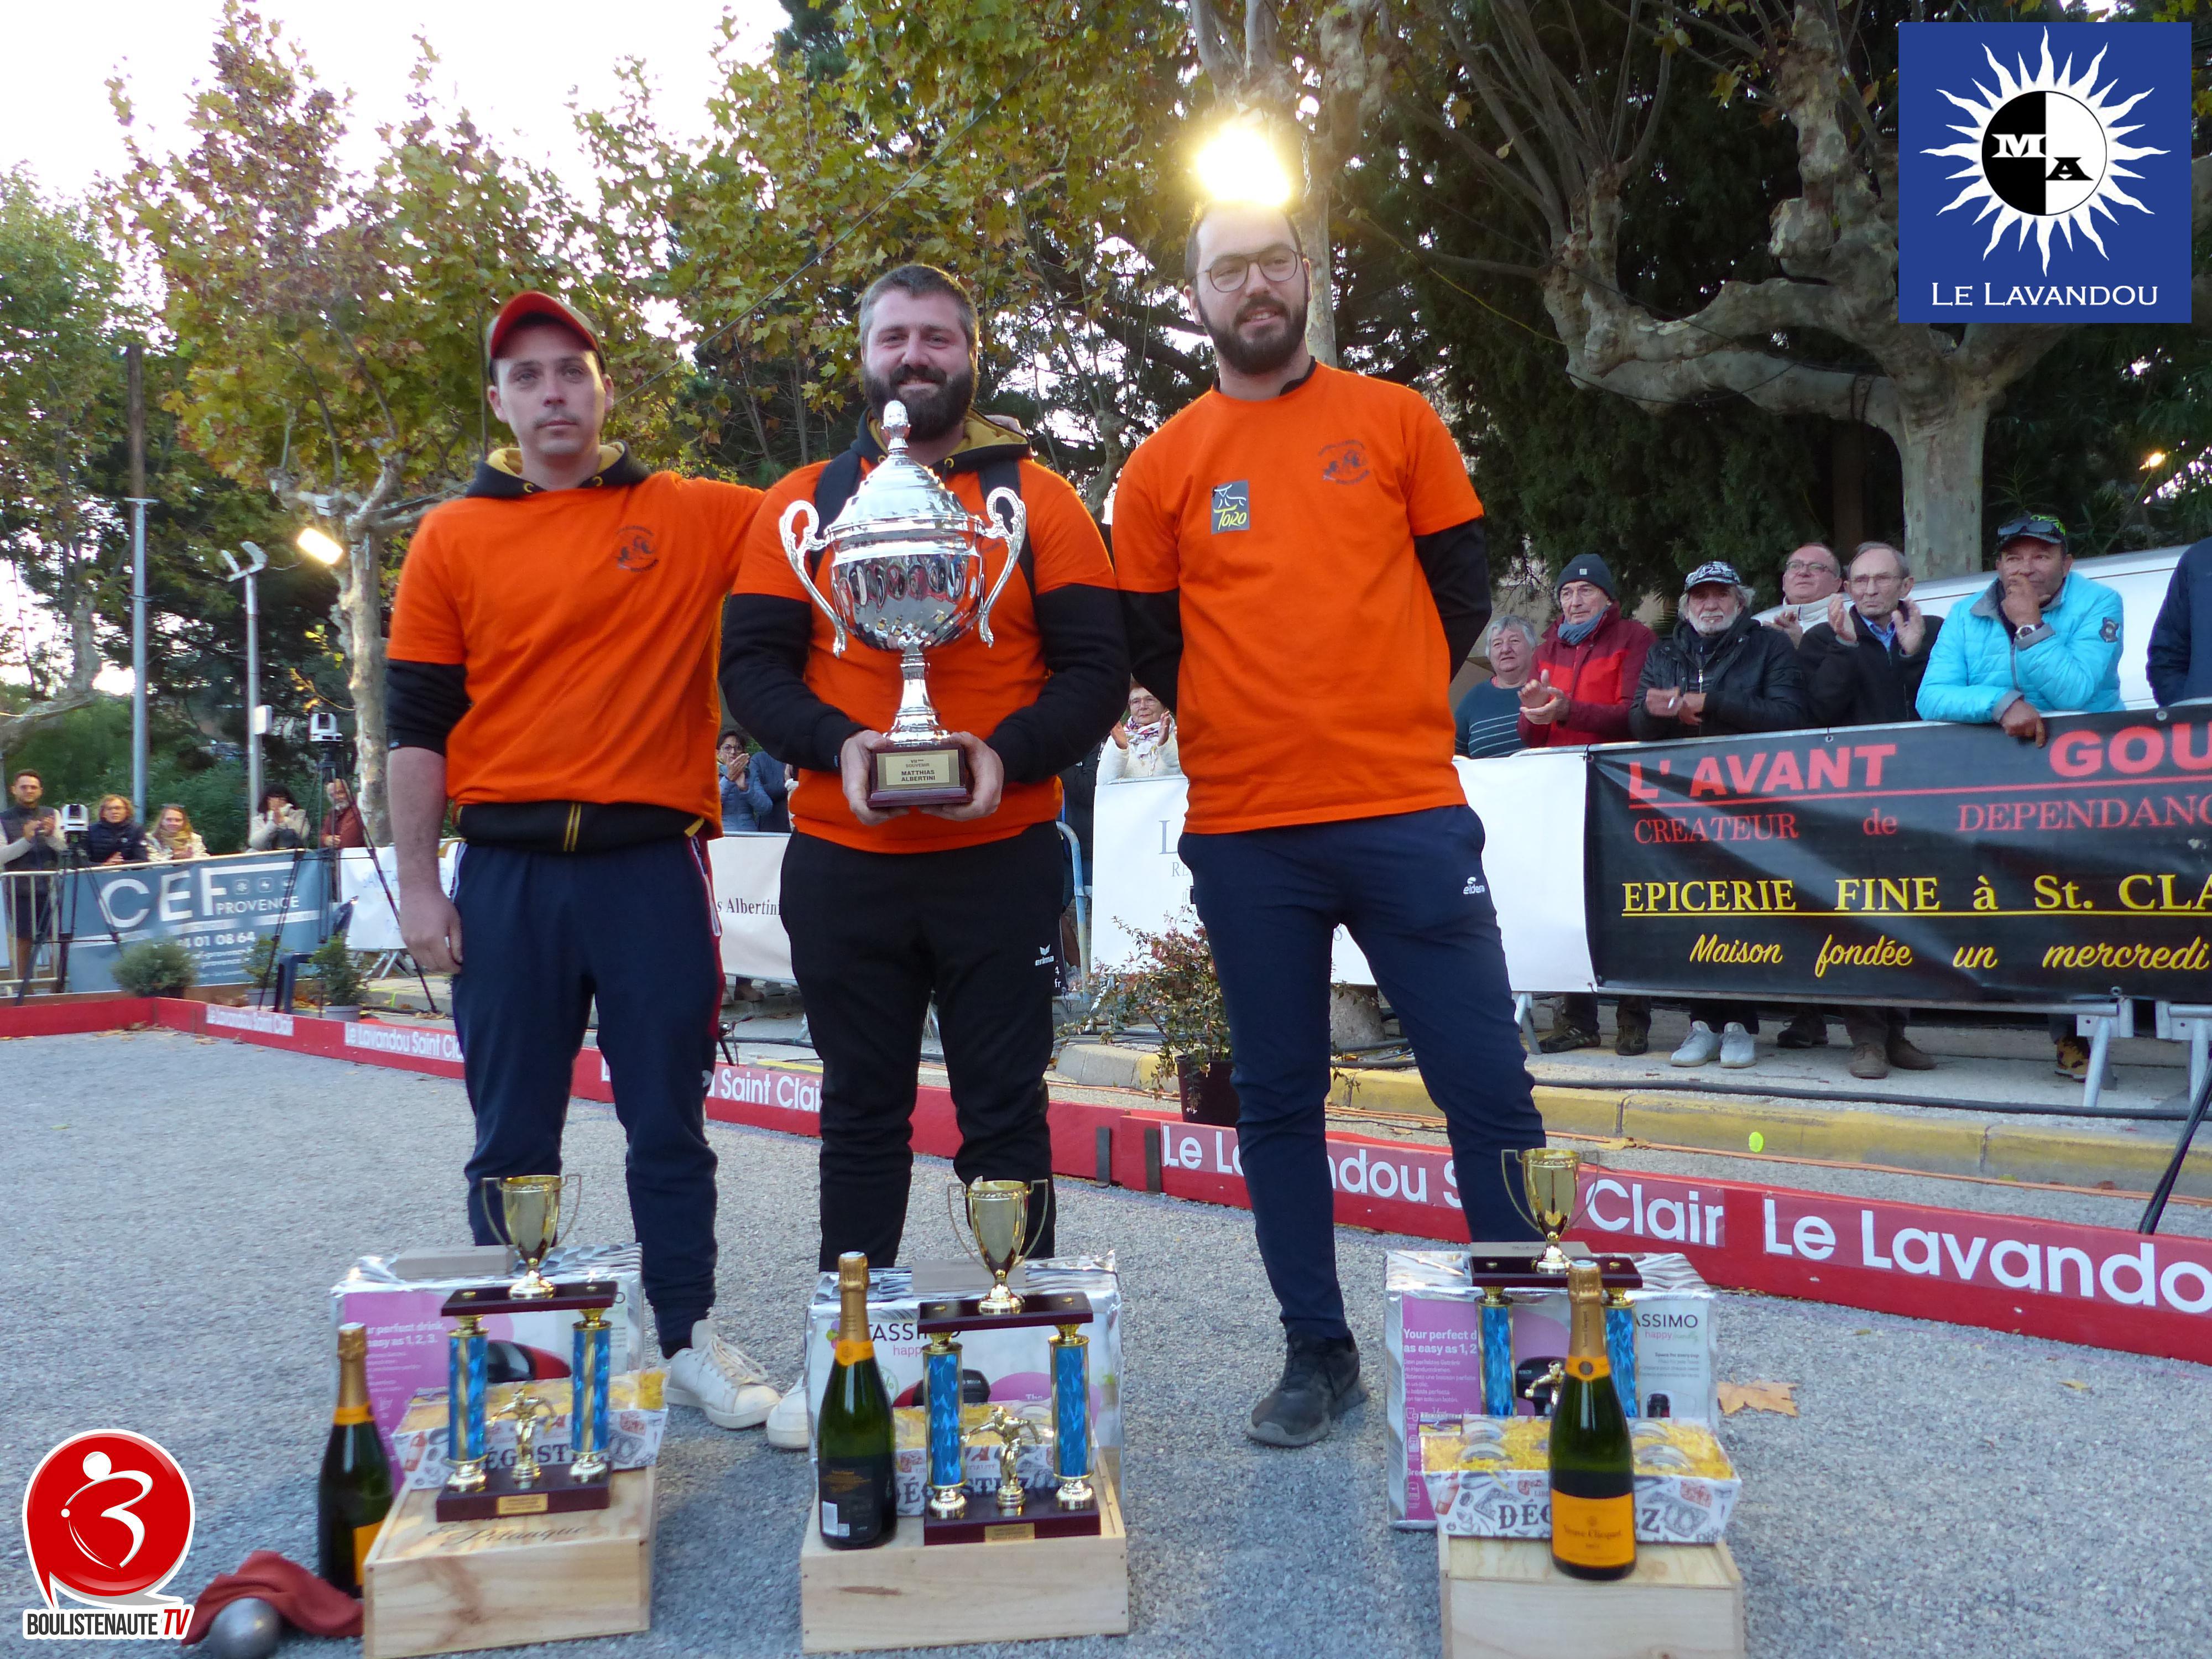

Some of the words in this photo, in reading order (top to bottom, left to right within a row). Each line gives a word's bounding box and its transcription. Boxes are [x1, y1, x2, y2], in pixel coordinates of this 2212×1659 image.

[1689, 744, 1896, 797] AVANT
[1635, 813, 1799, 843] CREATEUR
[1863, 808, 1898, 836] de
[98, 861, 295, 928] CEF
[216, 896, 299, 915] PROVENCE
[1622, 880, 1796, 912] EPICERIE
[1834, 877, 1940, 910] FINE
[1973, 875, 1998, 910] à
[2034, 875, 2093, 909] St.
[194, 935, 210, 947] 01
[215, 933, 234, 945] 08
[237, 931, 256, 943] 64
[1689, 934, 1783, 963] Maison
[1814, 934, 1912, 978] fondée
[1953, 946, 1998, 968] un
[2042, 936, 2210, 970] mercredi
[1035, 956, 1054, 966] erima
[206, 1006, 215, 1024] Le
[218, 1008, 251, 1030] Lavandou
[252, 1011, 272, 1033] Saint
[273, 1015, 294, 1036] Clair
[345, 1023, 357, 1044] Le
[359, 1026, 410, 1052] Lavandou
[412, 1031, 440, 1057] Saint
[721, 1068, 771, 1104] Saint
[1162, 1125, 1203, 1169] Le
[1585, 1179, 1723, 1245] Clair
[1764, 1199, 1836, 1260] Le
[1404, 1329, 1427, 1339] Your
[1430, 1329, 1468, 1342] perfect
[1418, 1345, 1443, 1355] easy
[1645, 1331, 1672, 1340] happy
